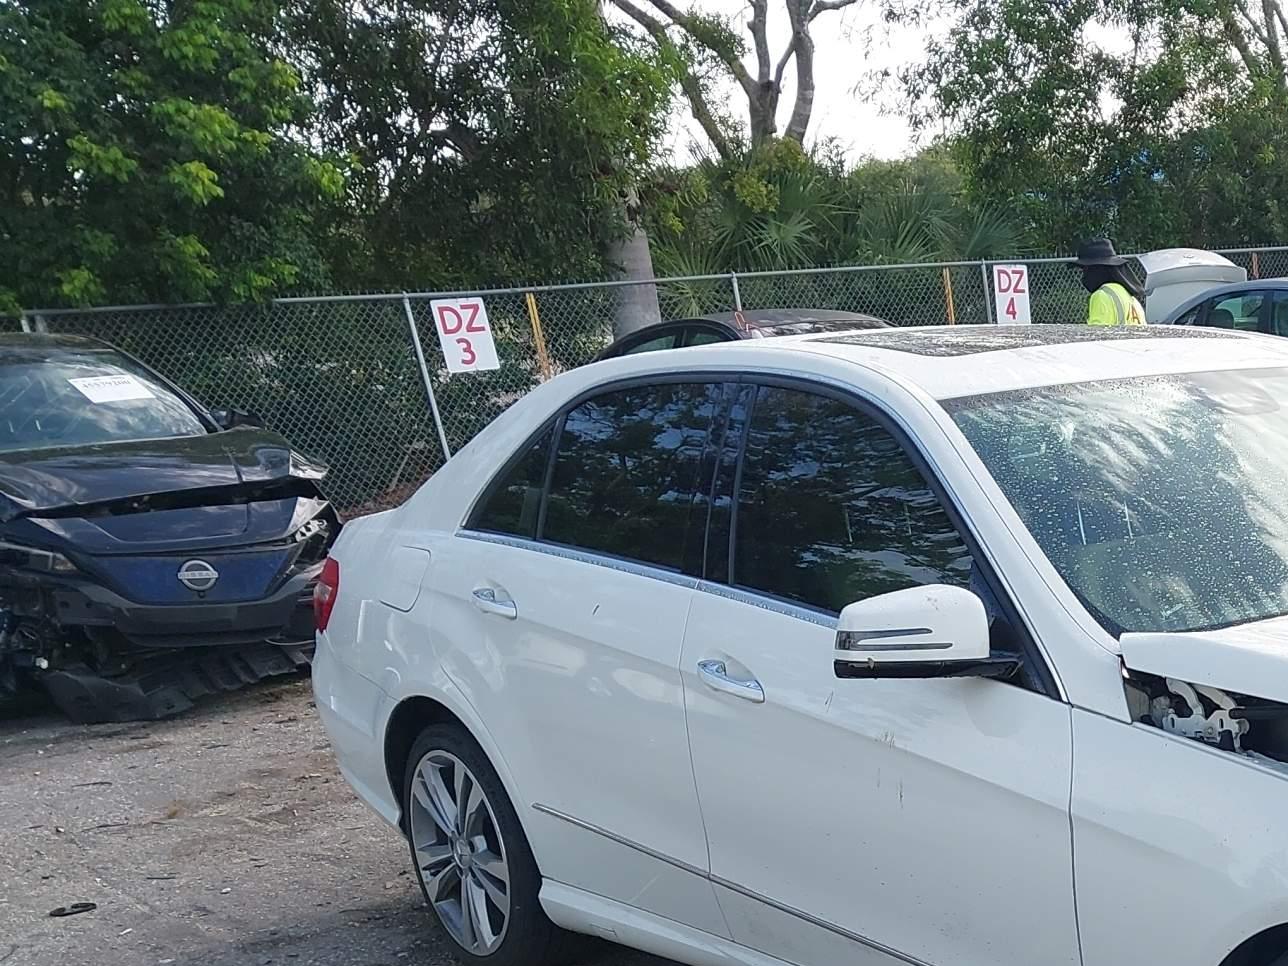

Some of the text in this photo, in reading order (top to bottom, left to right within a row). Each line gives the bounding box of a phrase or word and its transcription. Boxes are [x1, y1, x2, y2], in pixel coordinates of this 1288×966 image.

[996, 269, 1026, 294] DZ
[437, 303, 486, 335] DZ
[1006, 297, 1017, 320] 4
[455, 337, 476, 365] 3
